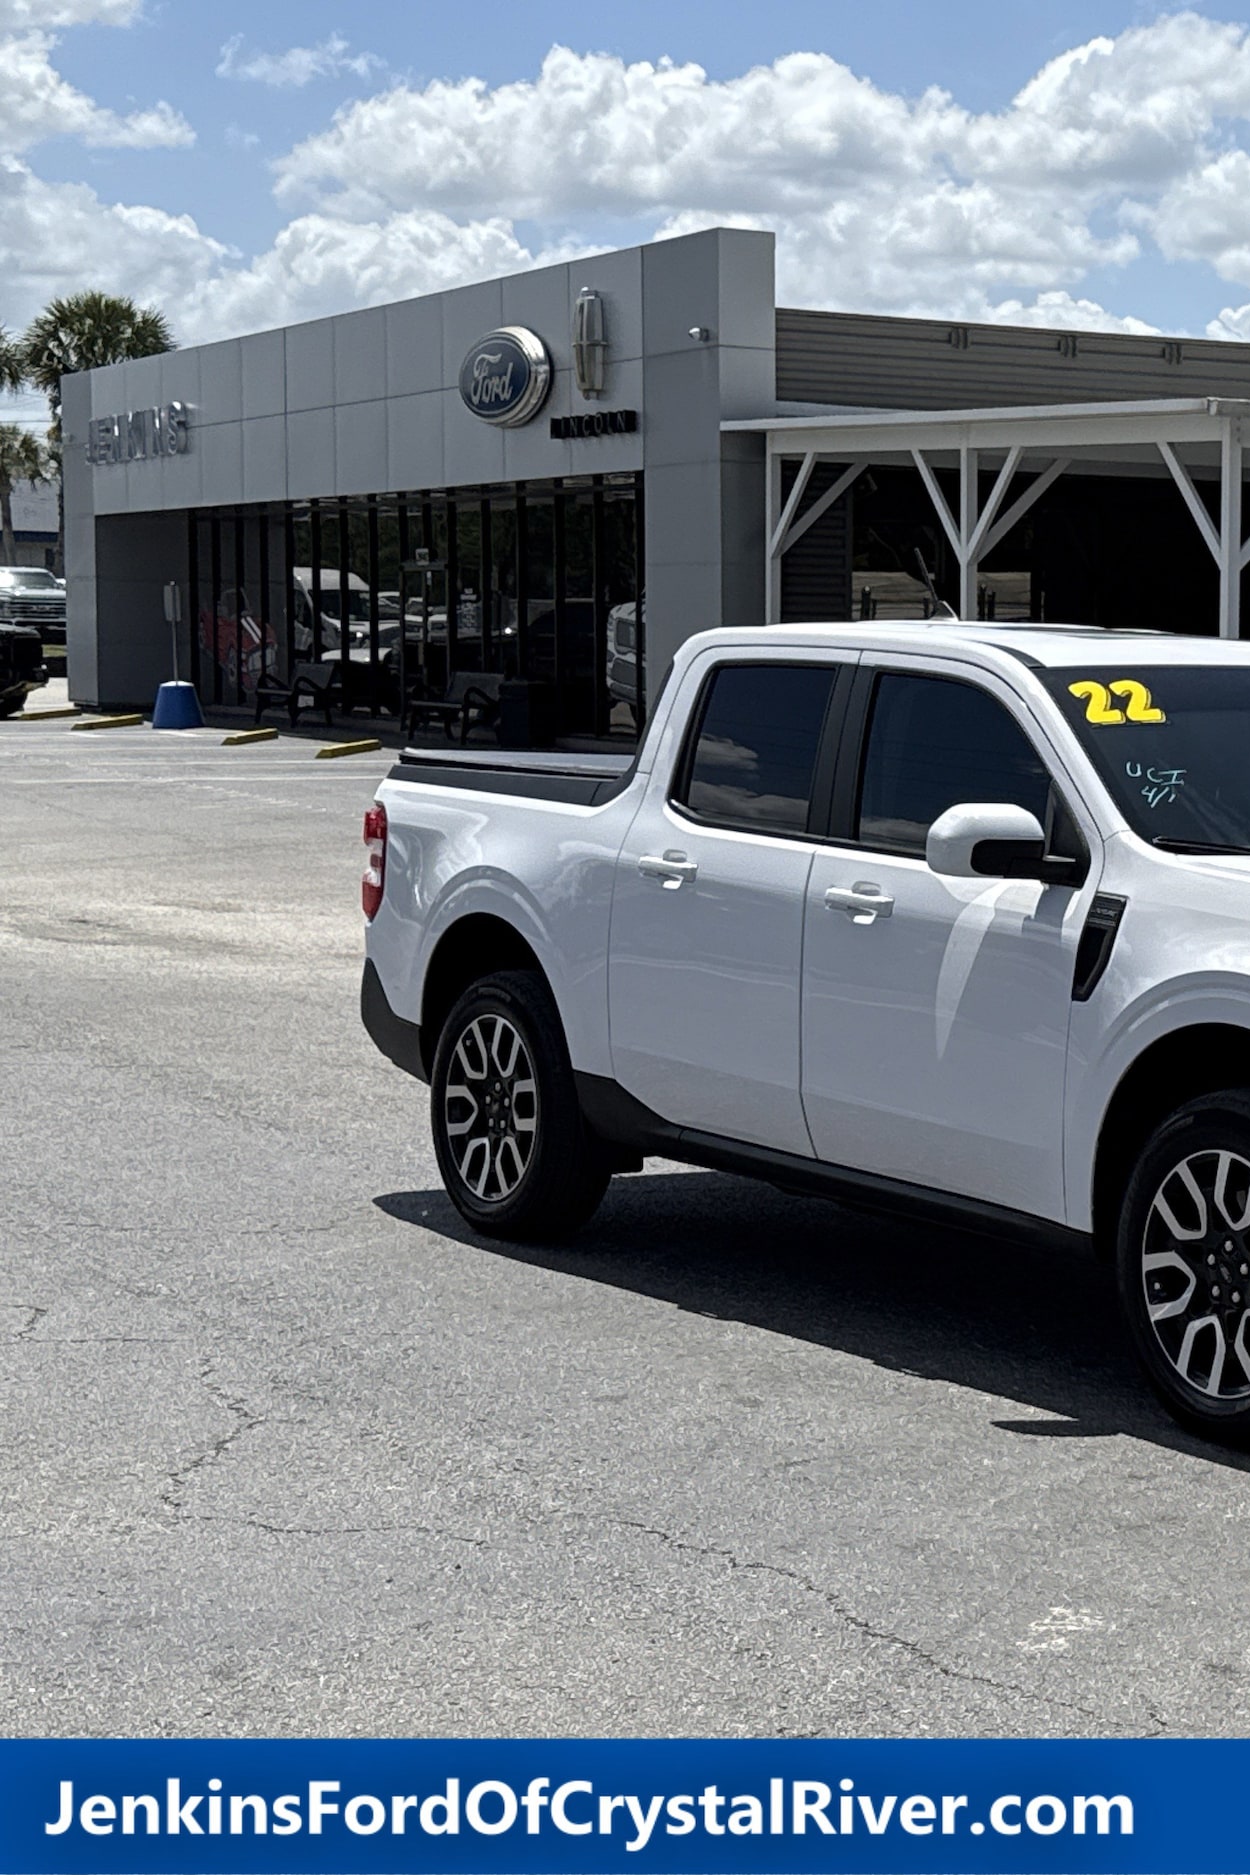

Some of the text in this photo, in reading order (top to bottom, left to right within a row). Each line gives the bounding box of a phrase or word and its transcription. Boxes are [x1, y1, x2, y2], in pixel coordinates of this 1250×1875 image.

[470, 353, 514, 406] Ford
[86, 402, 187, 464] JENKINS
[1067, 680, 1167, 725] 22
